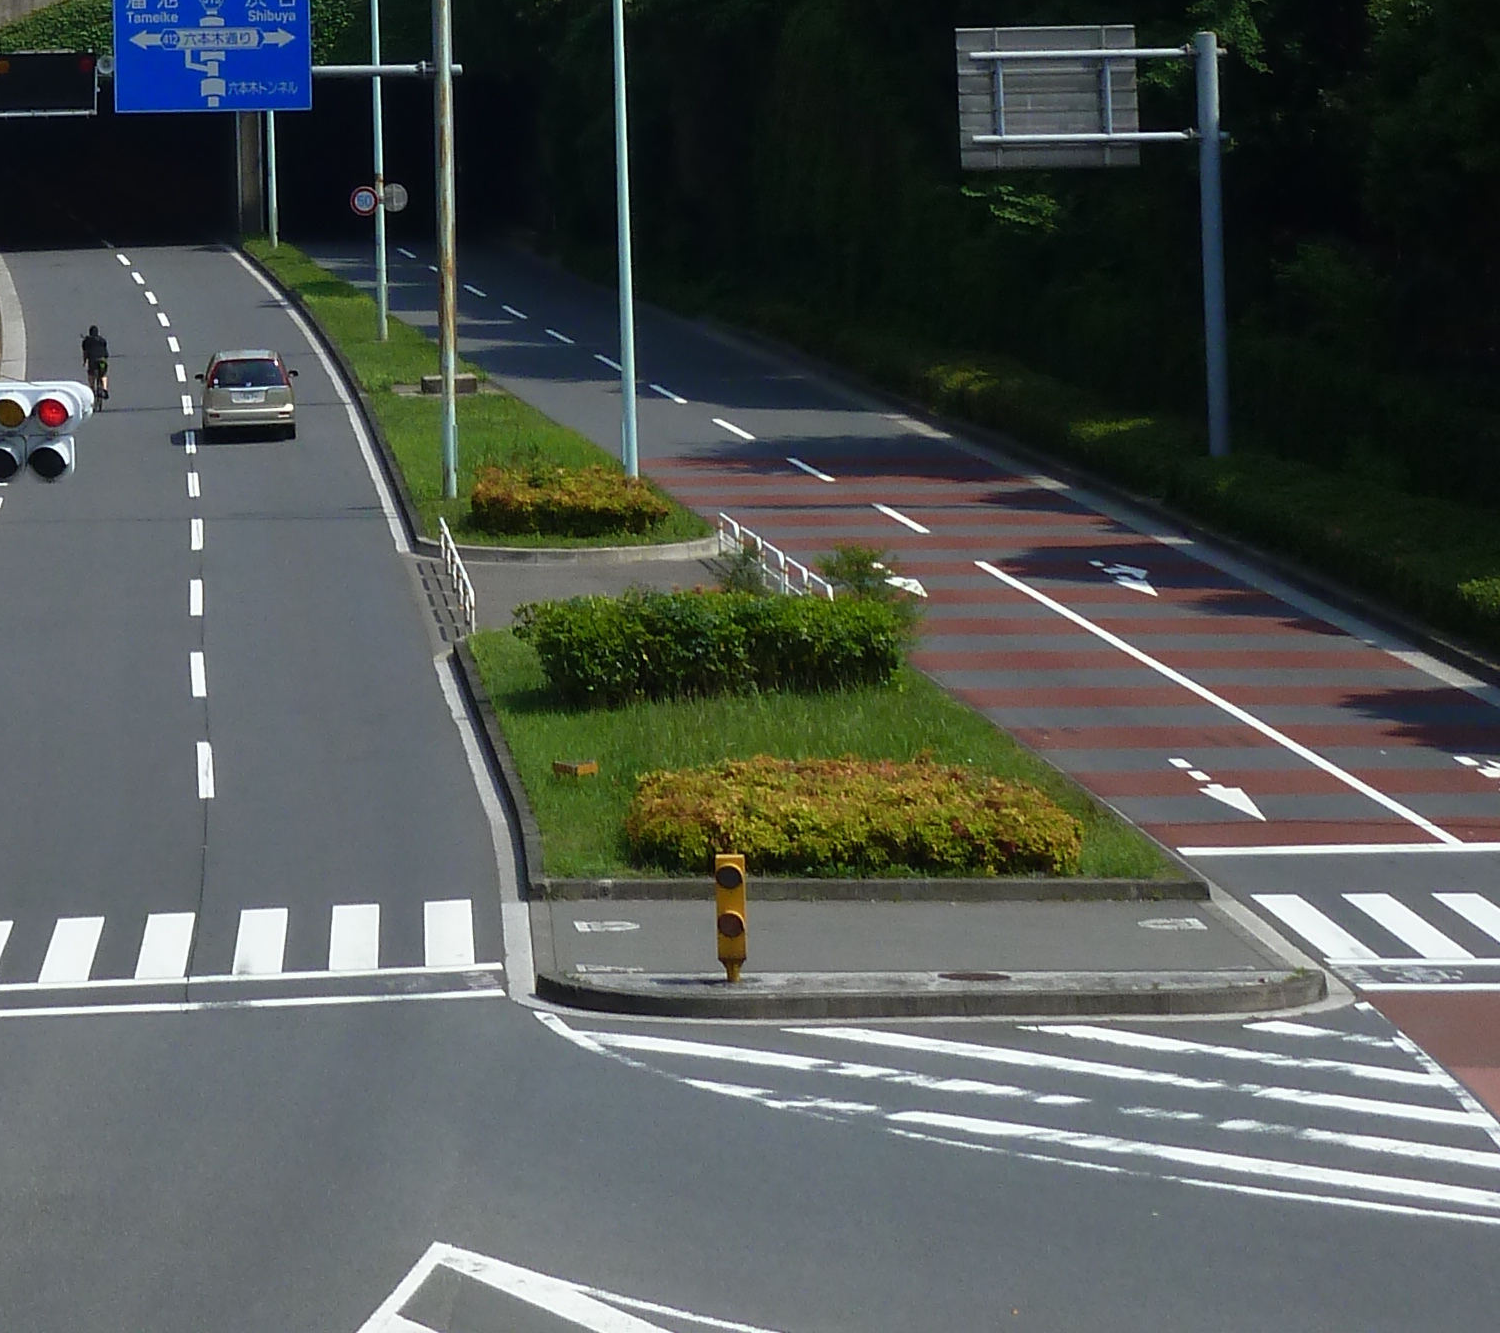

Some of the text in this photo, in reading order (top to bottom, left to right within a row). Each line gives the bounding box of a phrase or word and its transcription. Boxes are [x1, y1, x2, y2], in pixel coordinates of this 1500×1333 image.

[127, 12, 179, 24] Tameike
[248, 11, 296, 24] Shibuya
[163, 33, 179, 46] 412
[183, 31, 252, 47] 六本木通り
[228, 81, 299, 96] 六本木トンネル
